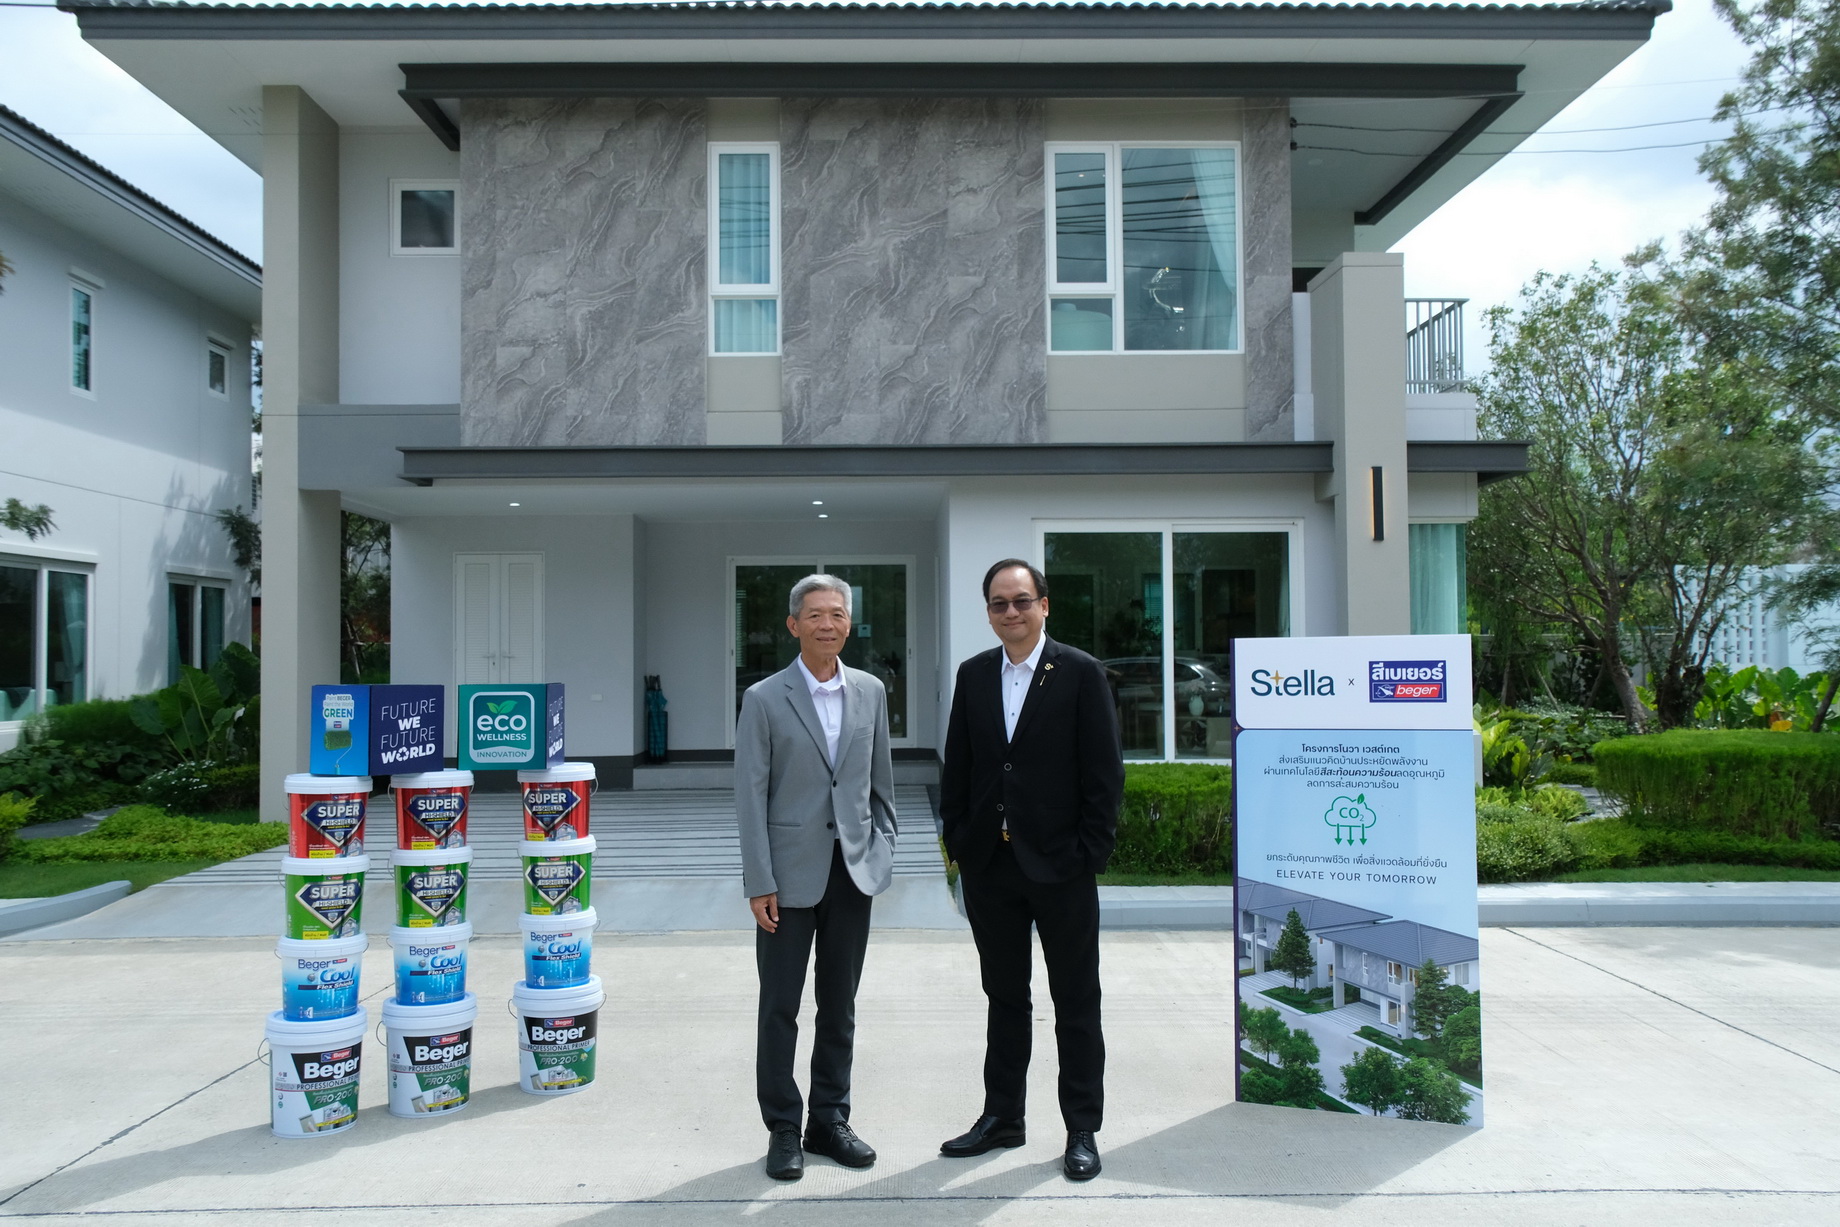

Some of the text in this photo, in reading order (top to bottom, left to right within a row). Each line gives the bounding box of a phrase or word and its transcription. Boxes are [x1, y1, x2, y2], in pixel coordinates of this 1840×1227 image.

[1371, 662, 1444, 681] สีเบเยอร์
[1250, 669, 1336, 696] Stella
[1396, 685, 1437, 697] beger
[323, 708, 353, 718] GREEN
[381, 698, 436, 721] FUTURE
[398, 716, 421, 731] WE
[476, 714, 527, 732] eco
[380, 726, 436, 750] FUTURE
[476, 733, 527, 741] WELLNESS
[1302, 743, 1360, 753] โครงการโนวา
[417, 798, 459, 811] SUPER
[528, 792, 567, 804] SUPER
[317, 805, 360, 818] SUPER
[534, 865, 573, 878] SUPER
[1276, 869, 1437, 885] ELEVATE YOUR TOMORROW
[414, 875, 457, 889] SUPER
[311, 884, 355, 899] SUPER
[530, 932, 556, 944] Beger
[409, 945, 440, 957] Beger
[548, 941, 581, 955] Cool
[297, 958, 331, 971] Beger
[430, 952, 462, 969] Cool
[320, 967, 354, 983] Cool
[531, 1026, 586, 1045] Beger
[415, 1041, 469, 1063] Beger
[527, 1043, 570, 1051] PROFESSIONAL
[408, 1061, 456, 1072] PROFESSIONAL
[540, 1056, 578, 1065] PRO-200
[304, 1056, 360, 1079] Beger
[296, 1078, 347, 1090] PROFESSIONAL
[424, 1073, 462, 1086] PRO-200
[313, 1089, 353, 1104] PRO-200
